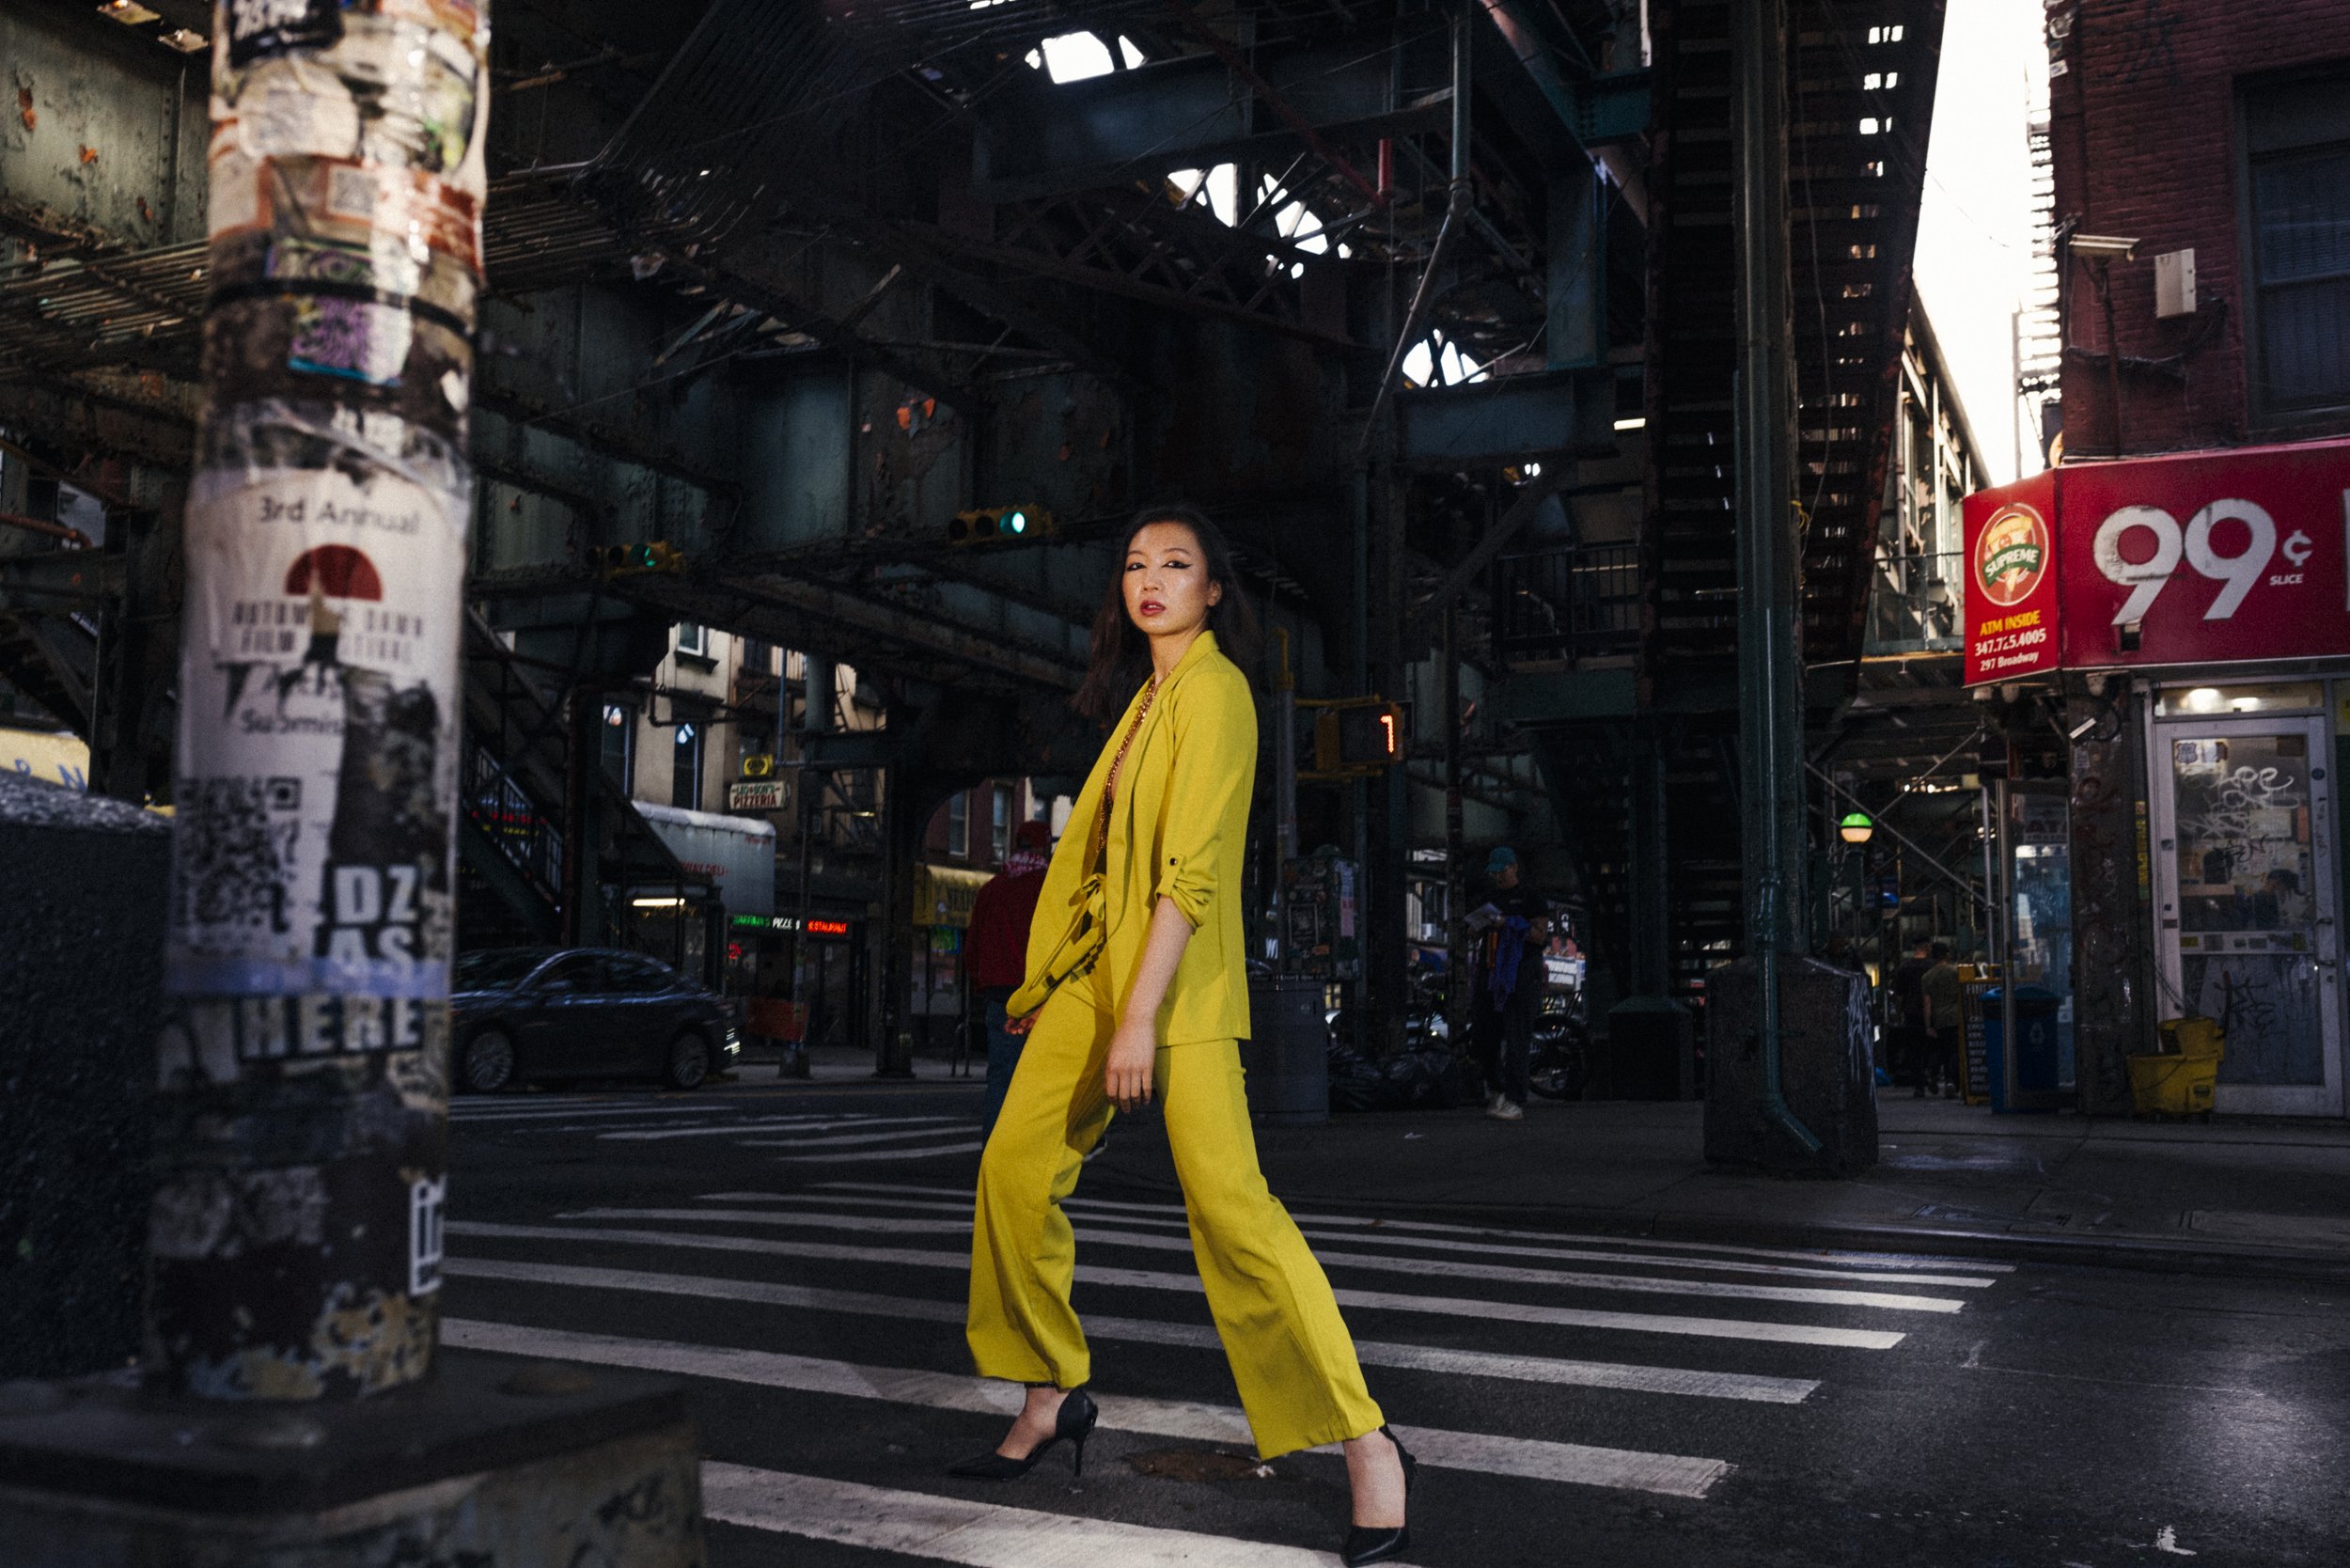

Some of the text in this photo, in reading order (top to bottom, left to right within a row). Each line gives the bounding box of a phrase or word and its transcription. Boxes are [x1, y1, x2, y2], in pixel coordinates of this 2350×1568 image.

[259, 496, 422, 535] 3rd Annual
[1984, 547, 2039, 578] SUPREME
[2269, 573, 2304, 587] SLICE
[1980, 609, 2042, 637] ATM INSIDE
[1980, 651, 2040, 673] 297 Broadway
[733, 794, 776, 808] PIZZERIA
